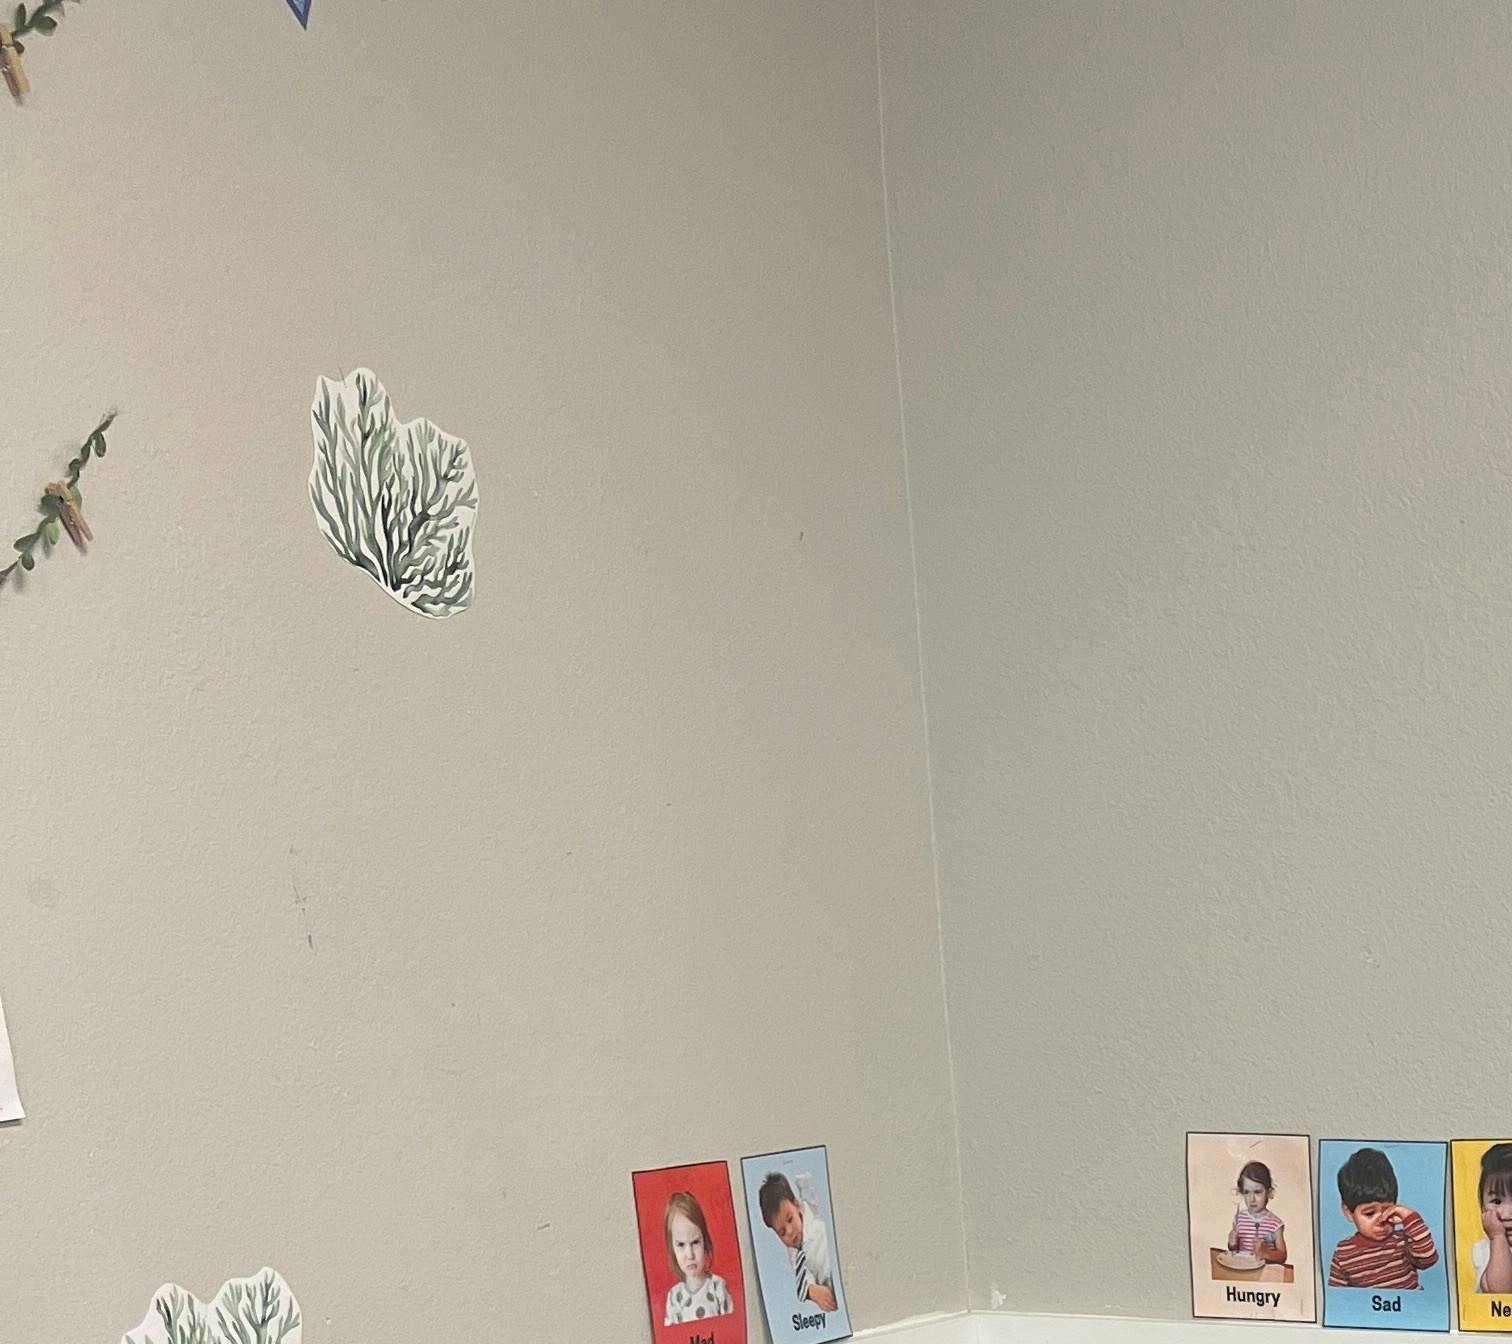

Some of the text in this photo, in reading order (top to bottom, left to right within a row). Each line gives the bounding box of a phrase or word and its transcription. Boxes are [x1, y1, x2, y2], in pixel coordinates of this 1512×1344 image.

[1226, 1286, 1281, 1308] Hungry
[1372, 1295, 1402, 1312] Sad
[792, 1312, 827, 1332] Sleepy
